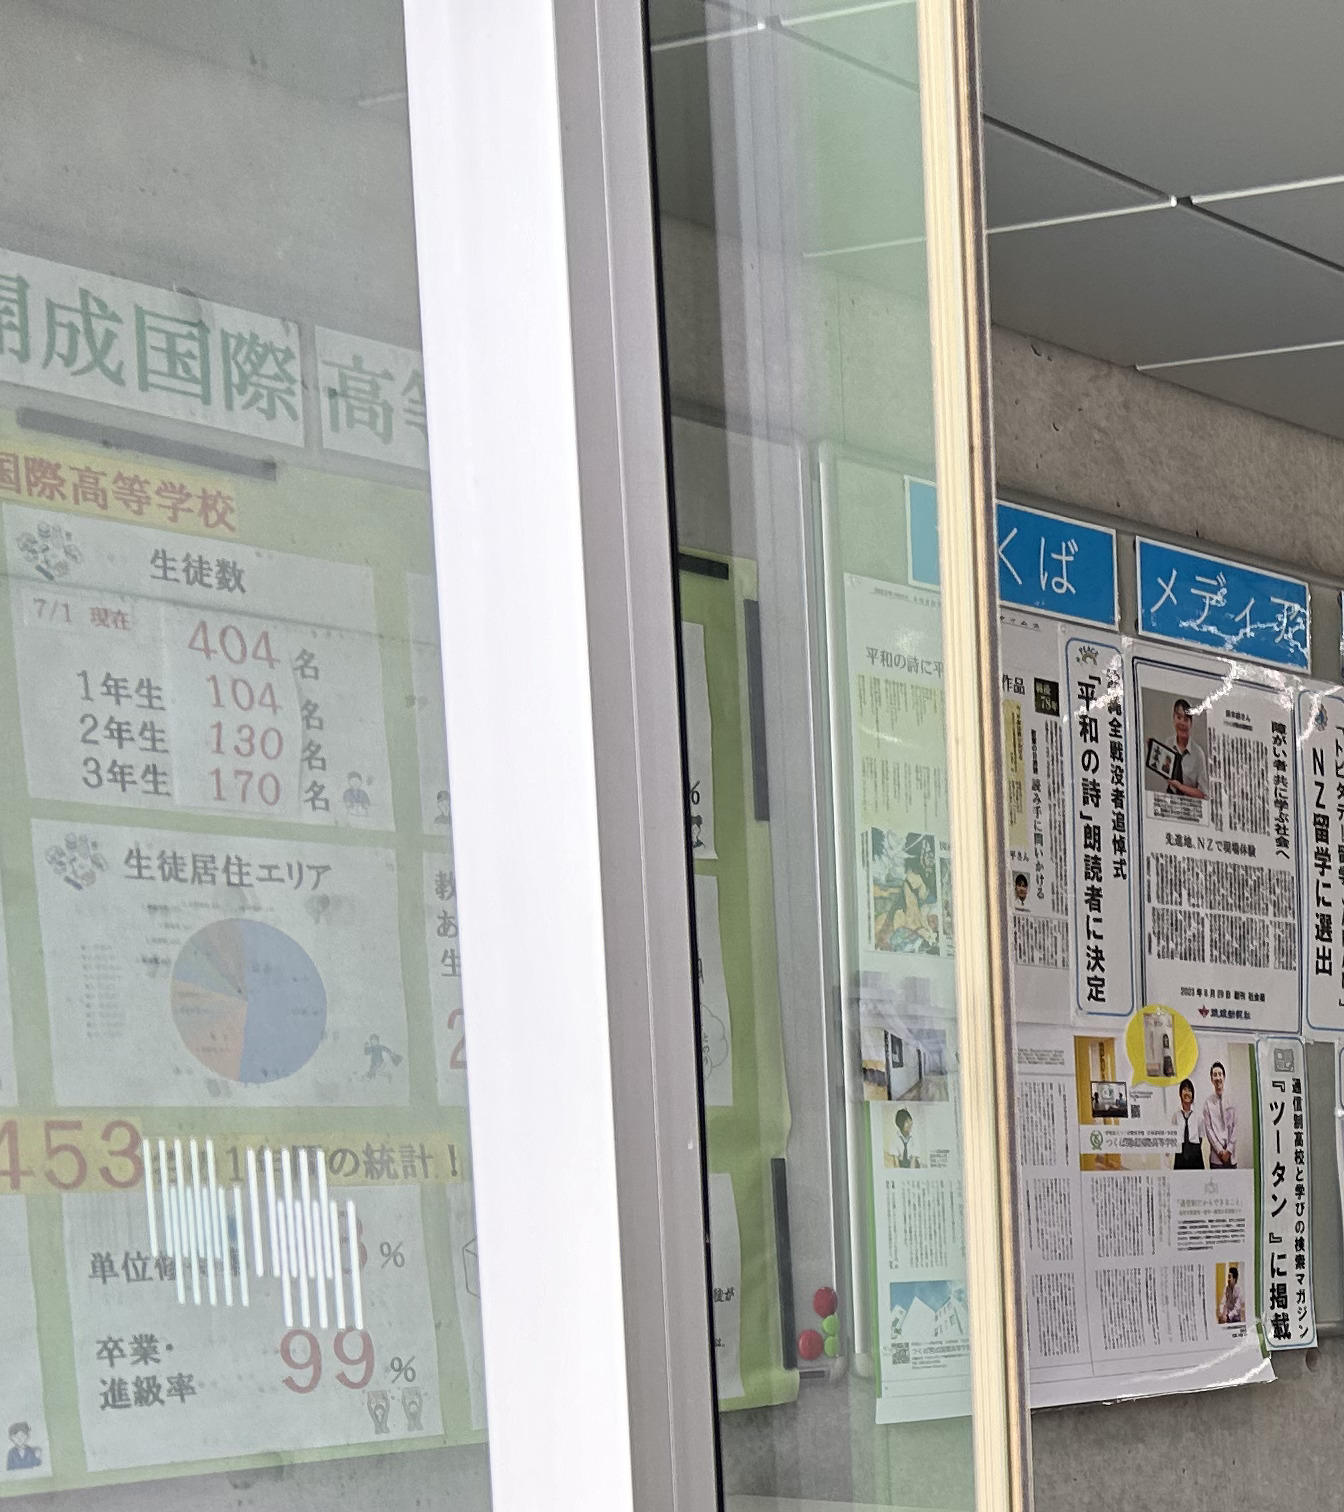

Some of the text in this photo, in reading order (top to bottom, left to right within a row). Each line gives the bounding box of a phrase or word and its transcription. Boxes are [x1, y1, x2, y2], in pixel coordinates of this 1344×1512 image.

[150, 549, 247, 594] 生徒数
[89, 606, 131, 632] 現在
[187, 620, 320, 681] 404 名
[76, 670, 324, 731] 1年生 104 名
[79, 713, 327, 772] 2年生 130 名
[82, 756, 330, 812] 3年生 170 名
[124, 847, 332, 891] 生徒居住エリア
[1311, 747, 1334, 976] NZ留学に選出
[0, 1118, 143, 1192] 453
[1269, 1080, 1292, 1341] 『ツータン』に掲載
[280, 1328, 375, 1393] 99
[390, 1356, 417, 1384] %
[98, 1373, 198, 1411] 進級率
